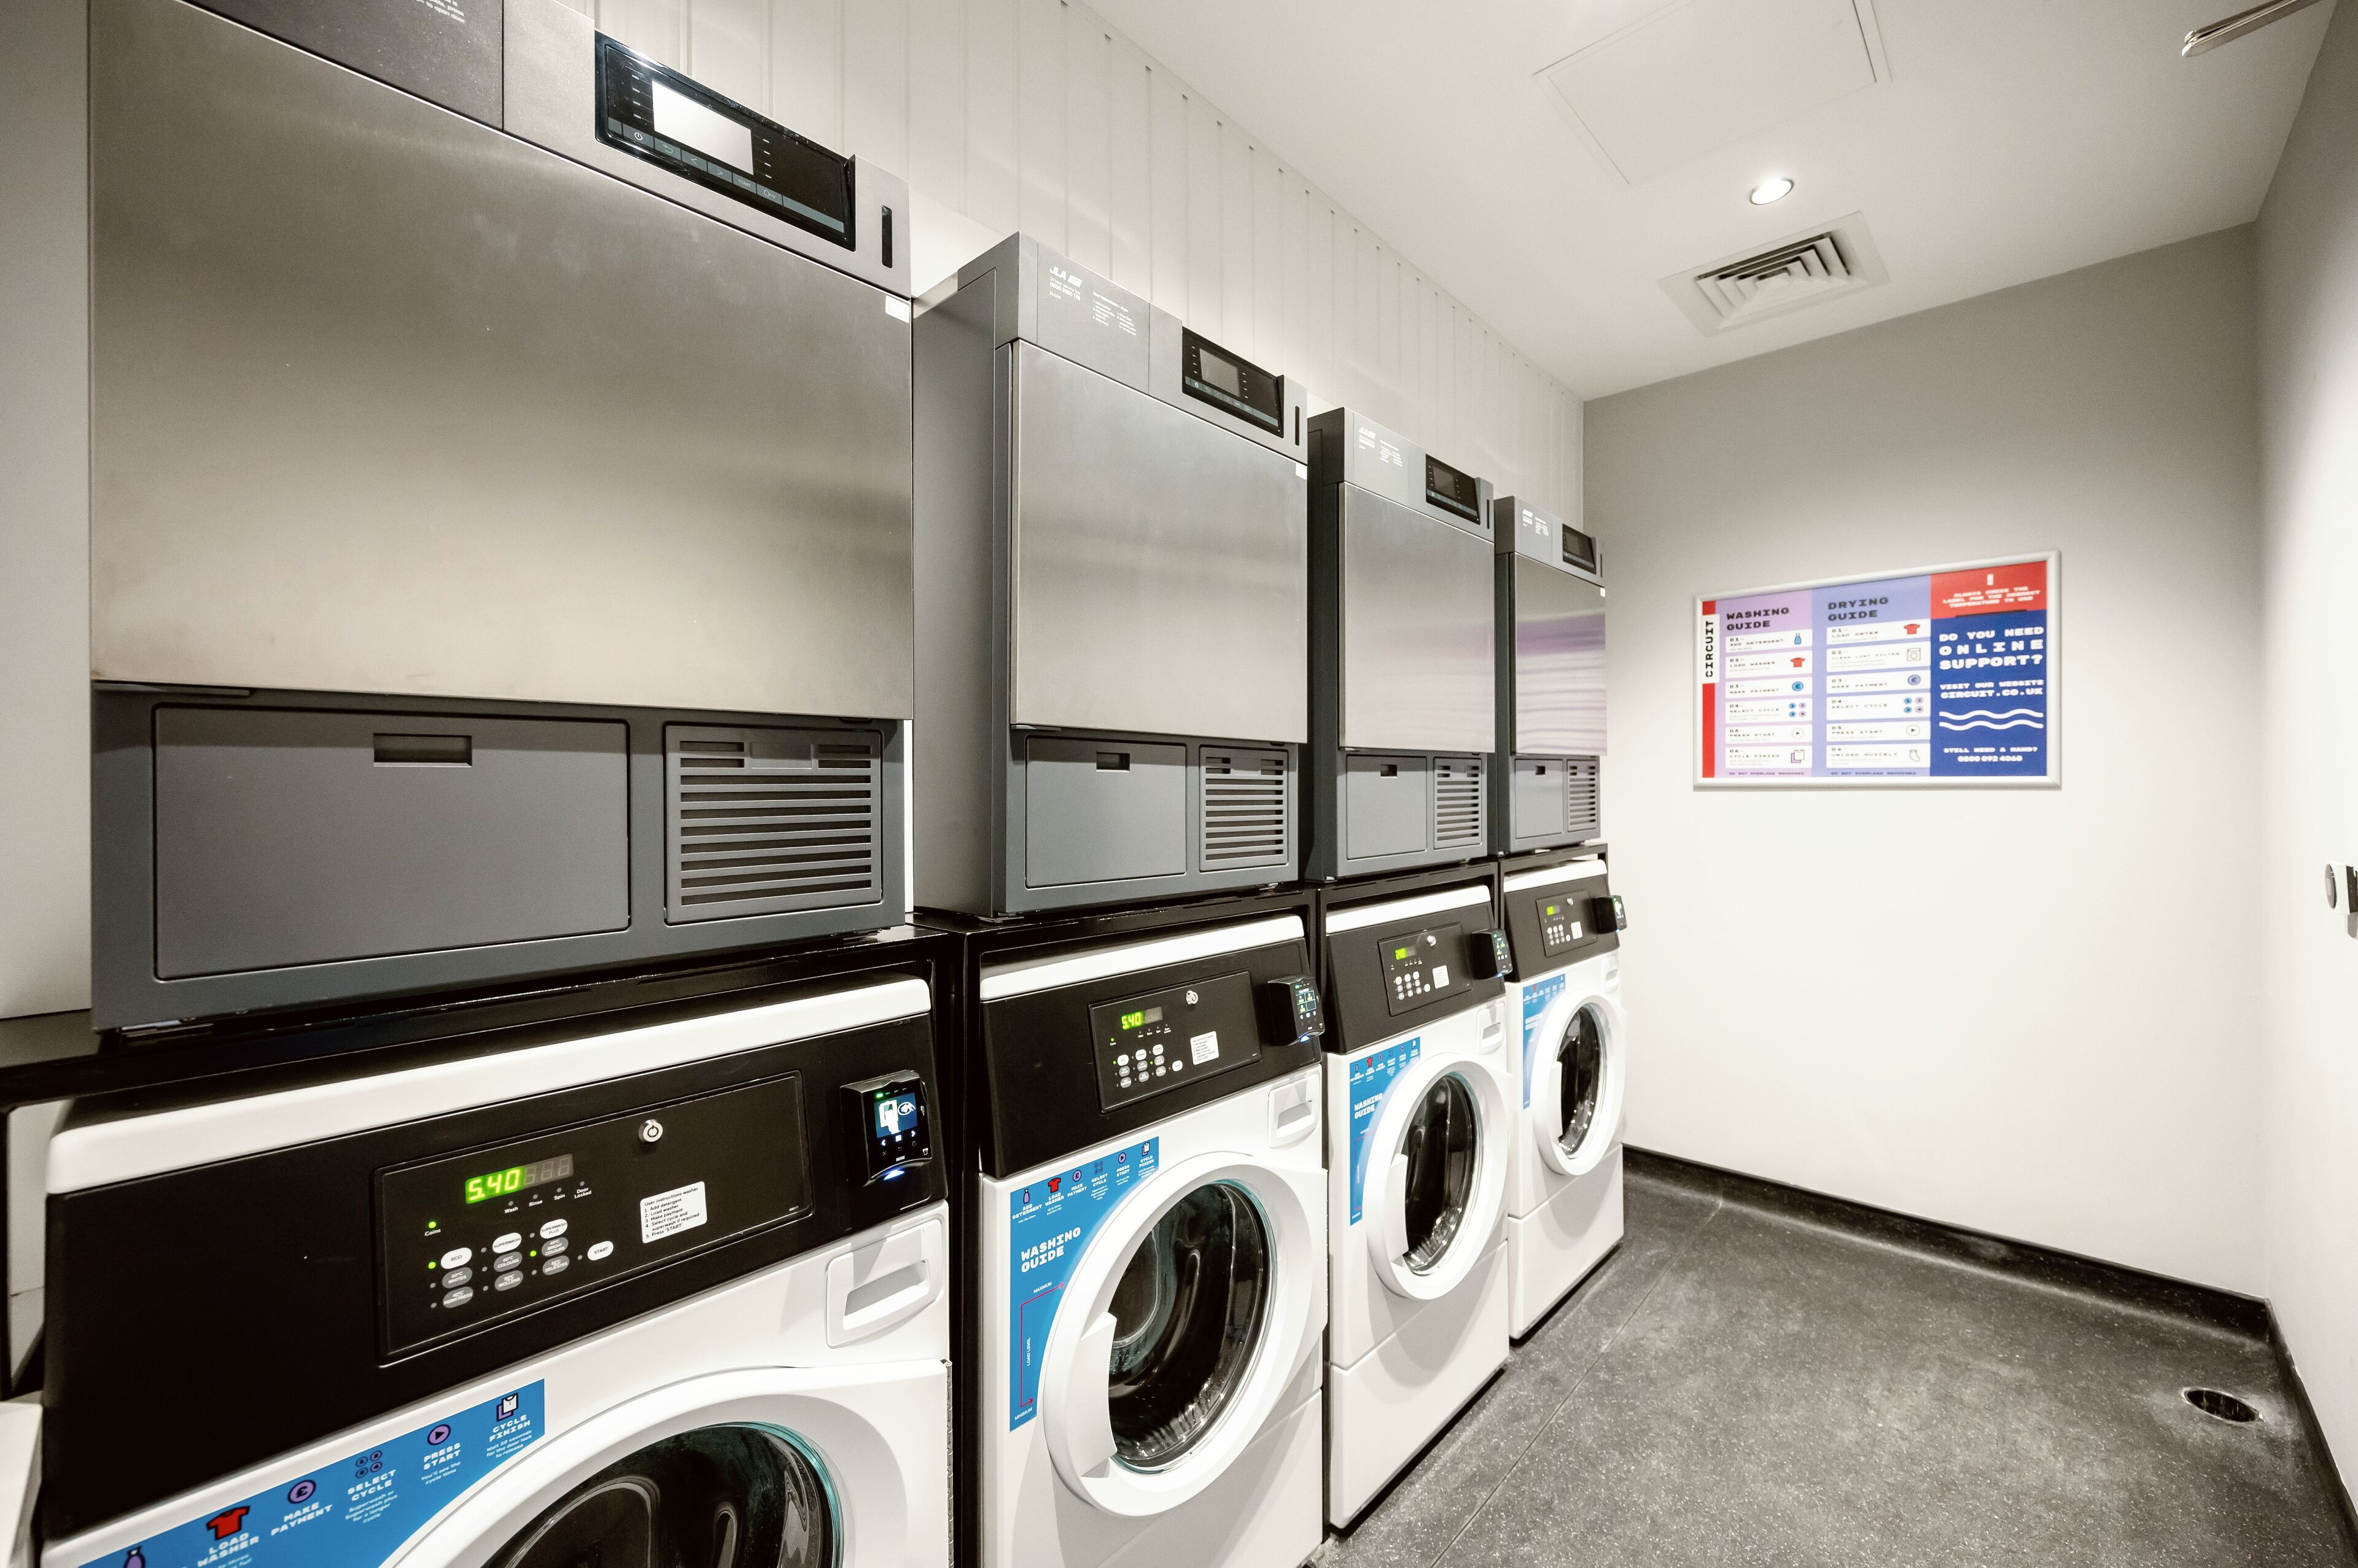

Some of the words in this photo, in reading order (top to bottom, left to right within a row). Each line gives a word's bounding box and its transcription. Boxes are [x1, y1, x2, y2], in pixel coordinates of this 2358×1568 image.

[1049, 266, 1067, 280] JLA
[1828, 597, 1889, 610] DRYING
[1726, 608, 1789, 620] WASHING
[1828, 610, 1878, 621] GUIDE
[1727, 621, 1770, 631] GUIDE
[1939, 633, 1958, 642] DO
[1967, 631, 1995, 639] YOU
[2004, 627, 2044, 637] NEED
[1939, 639, 2044, 656] ONLINE
[1939, 654, 2043, 670] SUPPORT?
[1940, 688, 2044, 699] CIRCUIT.CO.UK
[1354, 1093, 1383, 1111] WASHING
[1354, 1104, 1375, 1119] GUIDE
[469, 1169, 521, 1200] 5.40
[1091, 1173, 1108, 1182] SELECT
[574, 1190, 592, 1198] Locked
[656, 1192, 682, 1203] instructions
[1067, 1186, 1088, 1197] PAYMENT
[660, 1198, 682, 1208] detergent
[1045, 1195, 1065, 1206] WASHER
[663, 1205, 679, 1213] washer
[664, 1208, 683, 1217] payment
[1012, 1205, 1043, 1219] DETERGENT
[541, 1222, 567, 1233] SUPERWASH
[652, 1221, 676, 1231] superwash
[681, 1213, 699, 1222] required
[493, 1238, 521, 1248] SUPERWASH
[1021, 1227, 1081, 1261] WASHING
[545, 1246, 565, 1256] COLOURS
[497, 1259, 519, 1268] COLOURS
[1021, 1245, 1064, 1273] GUIDE
[545, 1262, 568, 1272] DELICATES
[1033, 1282, 1052, 1294] MAXIMUM
[1014, 1407, 1033, 1421] MINIMUM
[489, 1420, 531, 1442] FINISH
[492, 1415, 527, 1433] CYCLE
[508, 1430, 532, 1442] seconds
[423, 1443, 461, 1462] PRESS
[503, 1444, 524, 1454] release
[423, 1450, 461, 1470] START
[348, 1469, 396, 1494] SELECT
[421, 1471, 438, 1481] You'll
[425, 1475, 442, 1485] cycle
[442, 1469, 457, 1477] time
[351, 1480, 392, 1501] CYCLE
[345, 1501, 383, 1520] Superwash
[383, 1494, 398, 1504] plus
[349, 1494, 386, 1512] Superwash
[369, 1504, 391, 1515] longer
[283, 1502, 319, 1522] MAKE
[363, 1513, 381, 1523] cycle
[270, 1505, 333, 1535] PAYMENT
[209, 1532, 249, 1554] LOAD
[196, 1536, 259, 1567] WASHER
